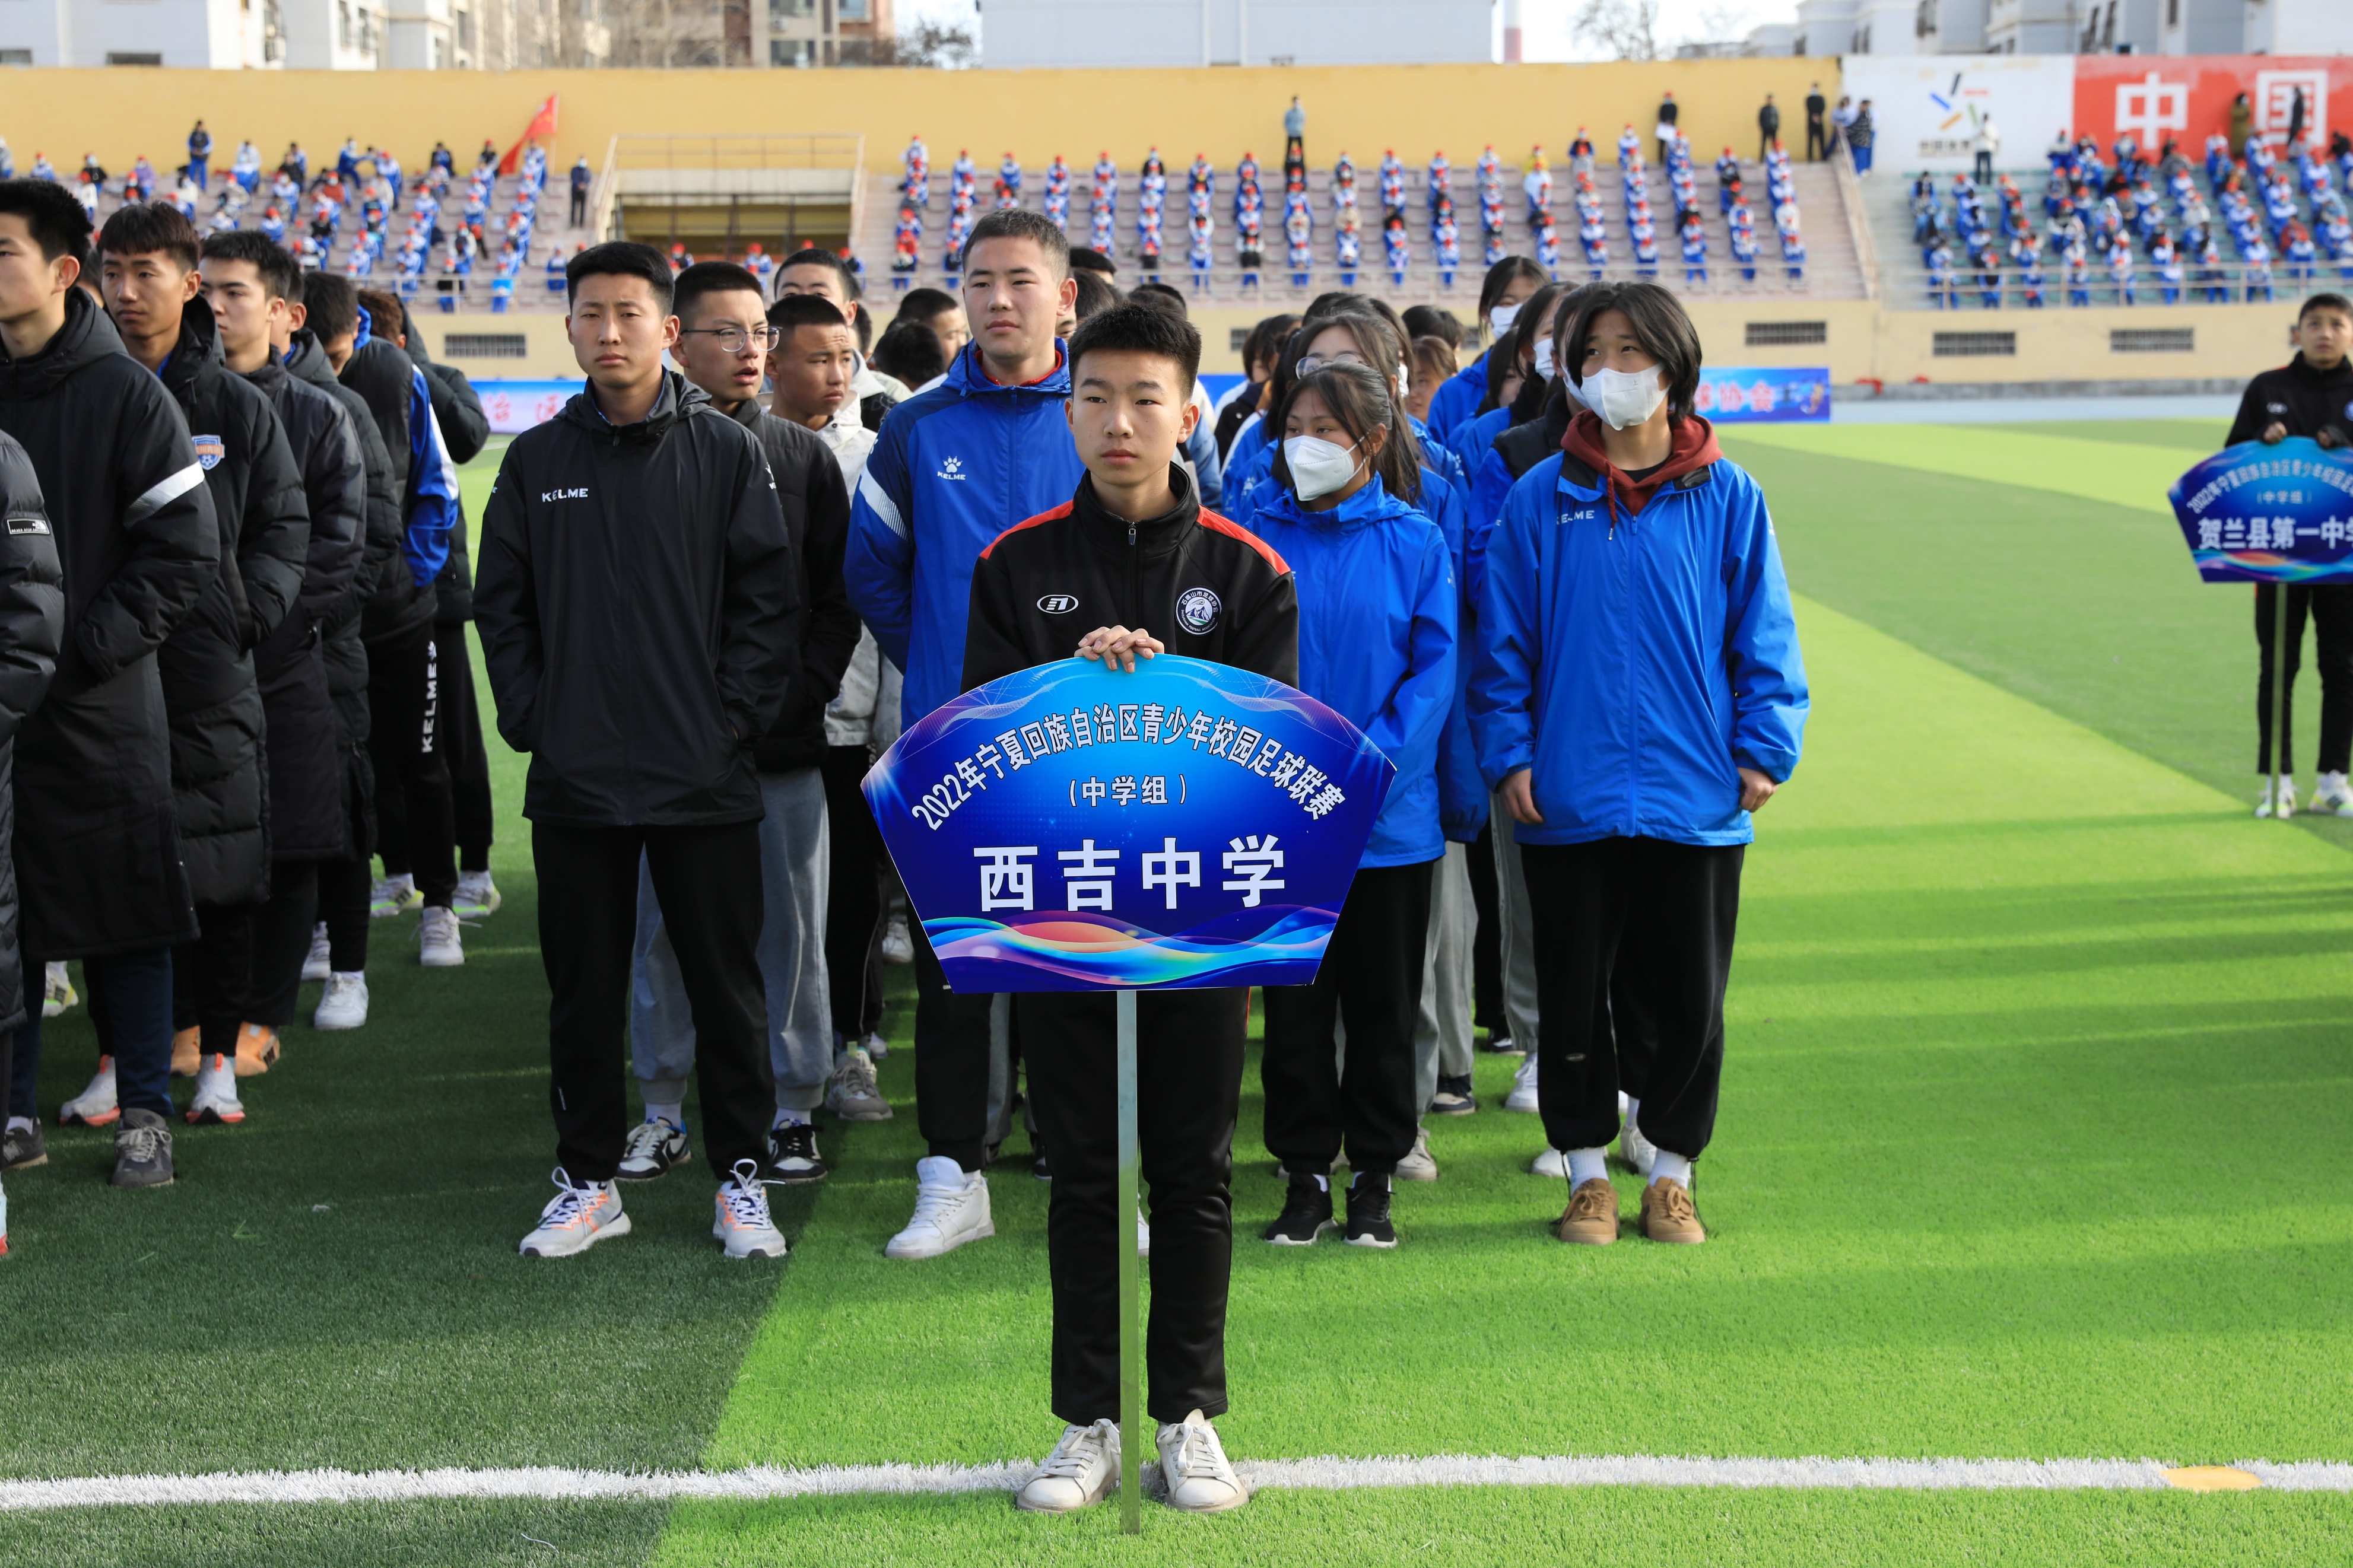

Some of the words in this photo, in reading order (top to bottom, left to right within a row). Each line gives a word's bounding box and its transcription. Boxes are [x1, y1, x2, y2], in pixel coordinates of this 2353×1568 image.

[2115, 69, 2328, 150] 中国
[542, 488, 589, 502] KELME
[937, 471, 966, 481] KELME
[421, 662, 437, 753] KELME
[911, 702, 1347, 831] 2022年宁夏回族自治区青少年校园足球联赛
[973, 834, 1285, 912] 西吉中学
